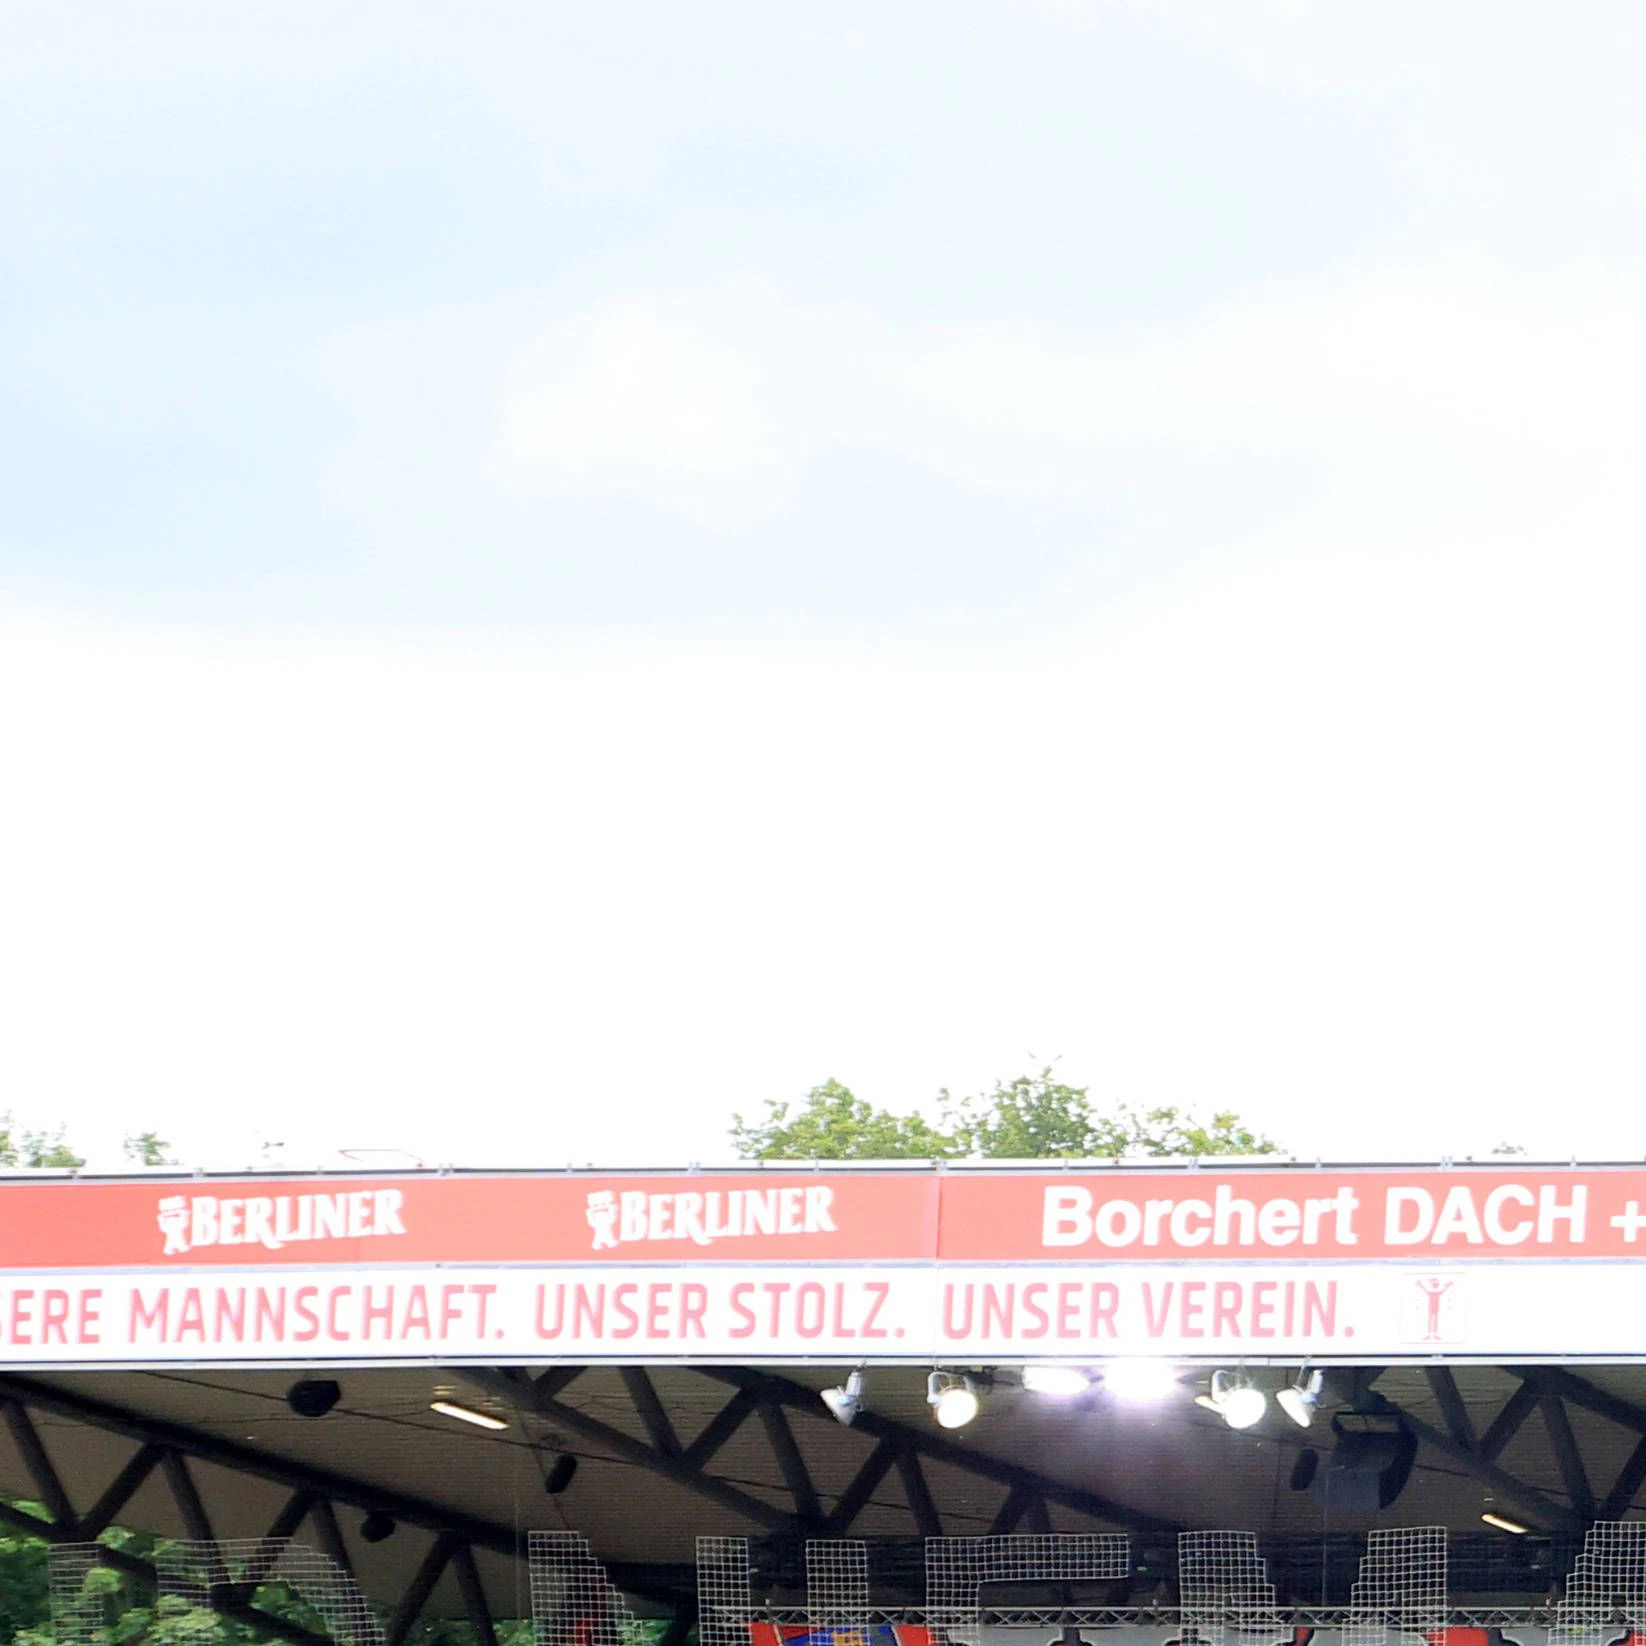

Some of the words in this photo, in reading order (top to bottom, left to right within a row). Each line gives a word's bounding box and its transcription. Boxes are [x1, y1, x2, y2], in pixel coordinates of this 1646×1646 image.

[191, 1187, 406, 1249] BERLINER
[620, 1185, 836, 1247] BERLINER
[1042, 1184, 1358, 1247] Borchert
[1384, 1183, 1586, 1245] DACH
[129, 1283, 505, 1343] MANNSCHAFT.
[535, 1283, 708, 1340] UNSER
[728, 1282, 905, 1339] STOLZ.
[942, 1281, 1118, 1340] UNSER
[1142, 1279, 1354, 1340] VEREIN.
